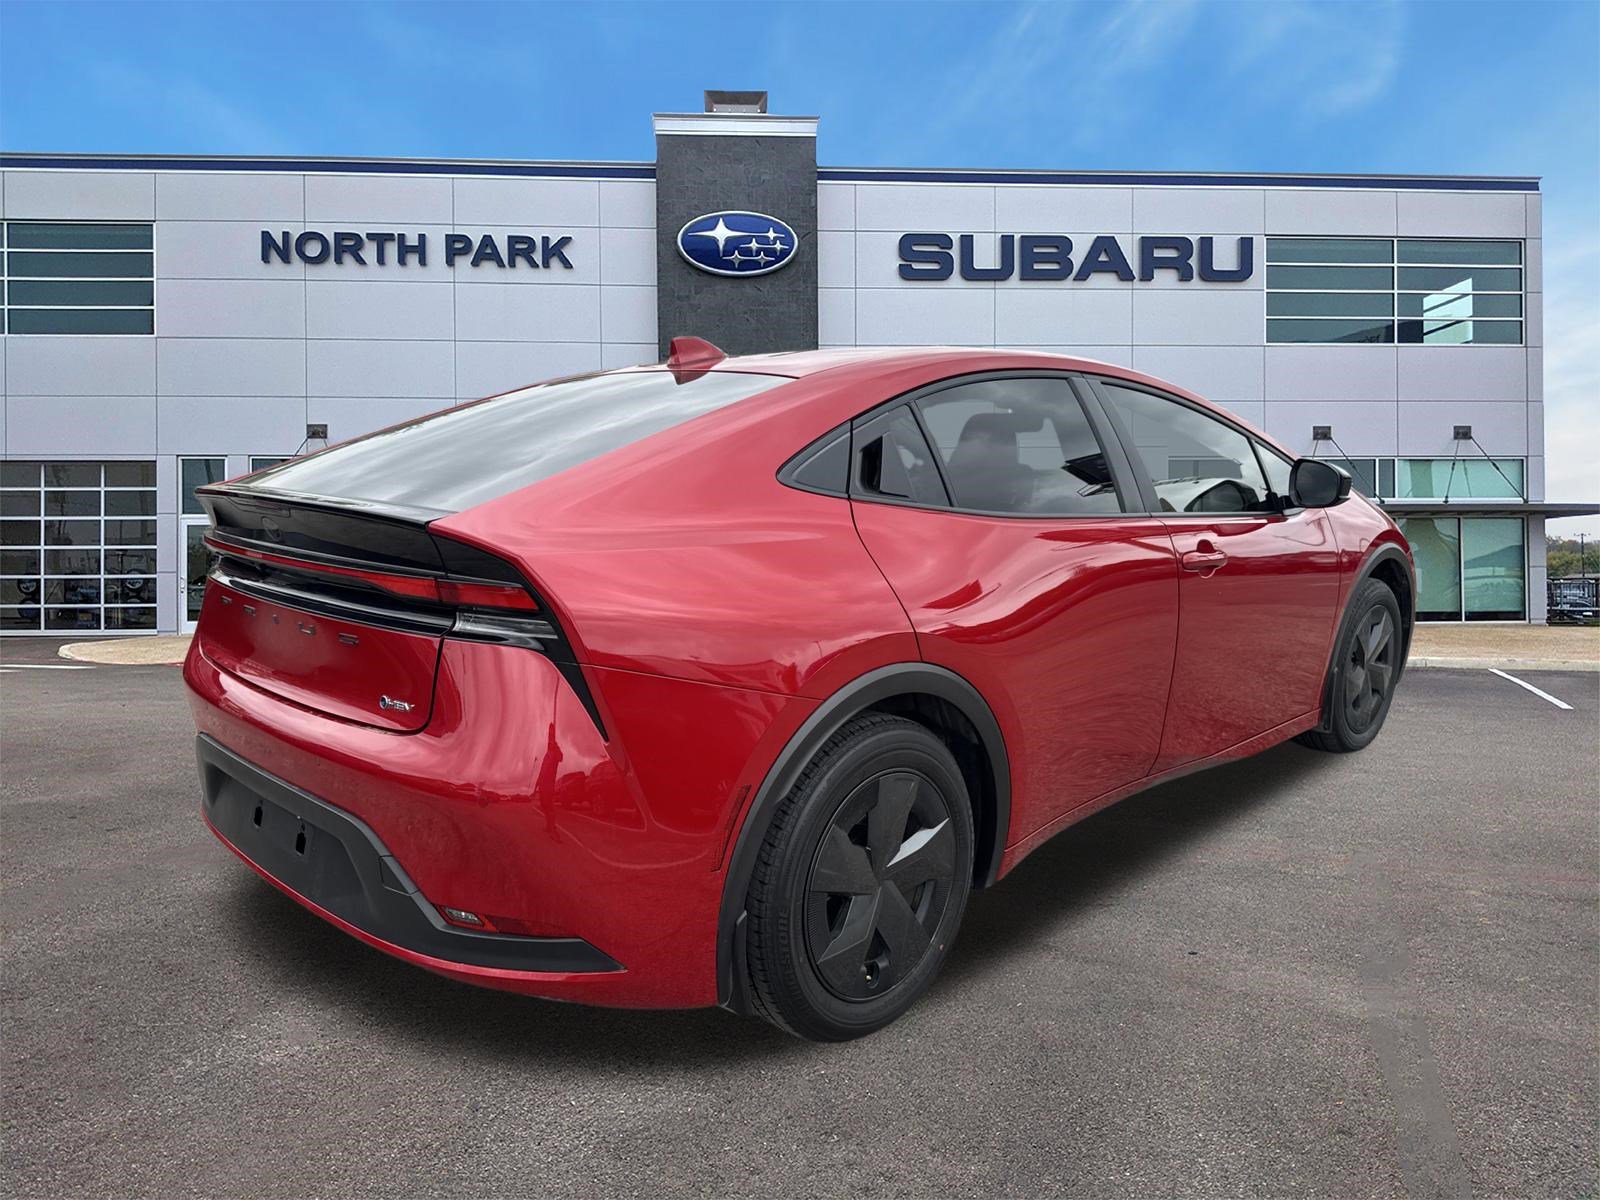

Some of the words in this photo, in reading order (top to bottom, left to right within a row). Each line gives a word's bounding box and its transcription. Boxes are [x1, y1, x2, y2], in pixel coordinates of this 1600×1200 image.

[260, 230, 427, 267] NORTH
[444, 233, 574, 269] PARK
[898, 232, 1255, 282] SUBARU
